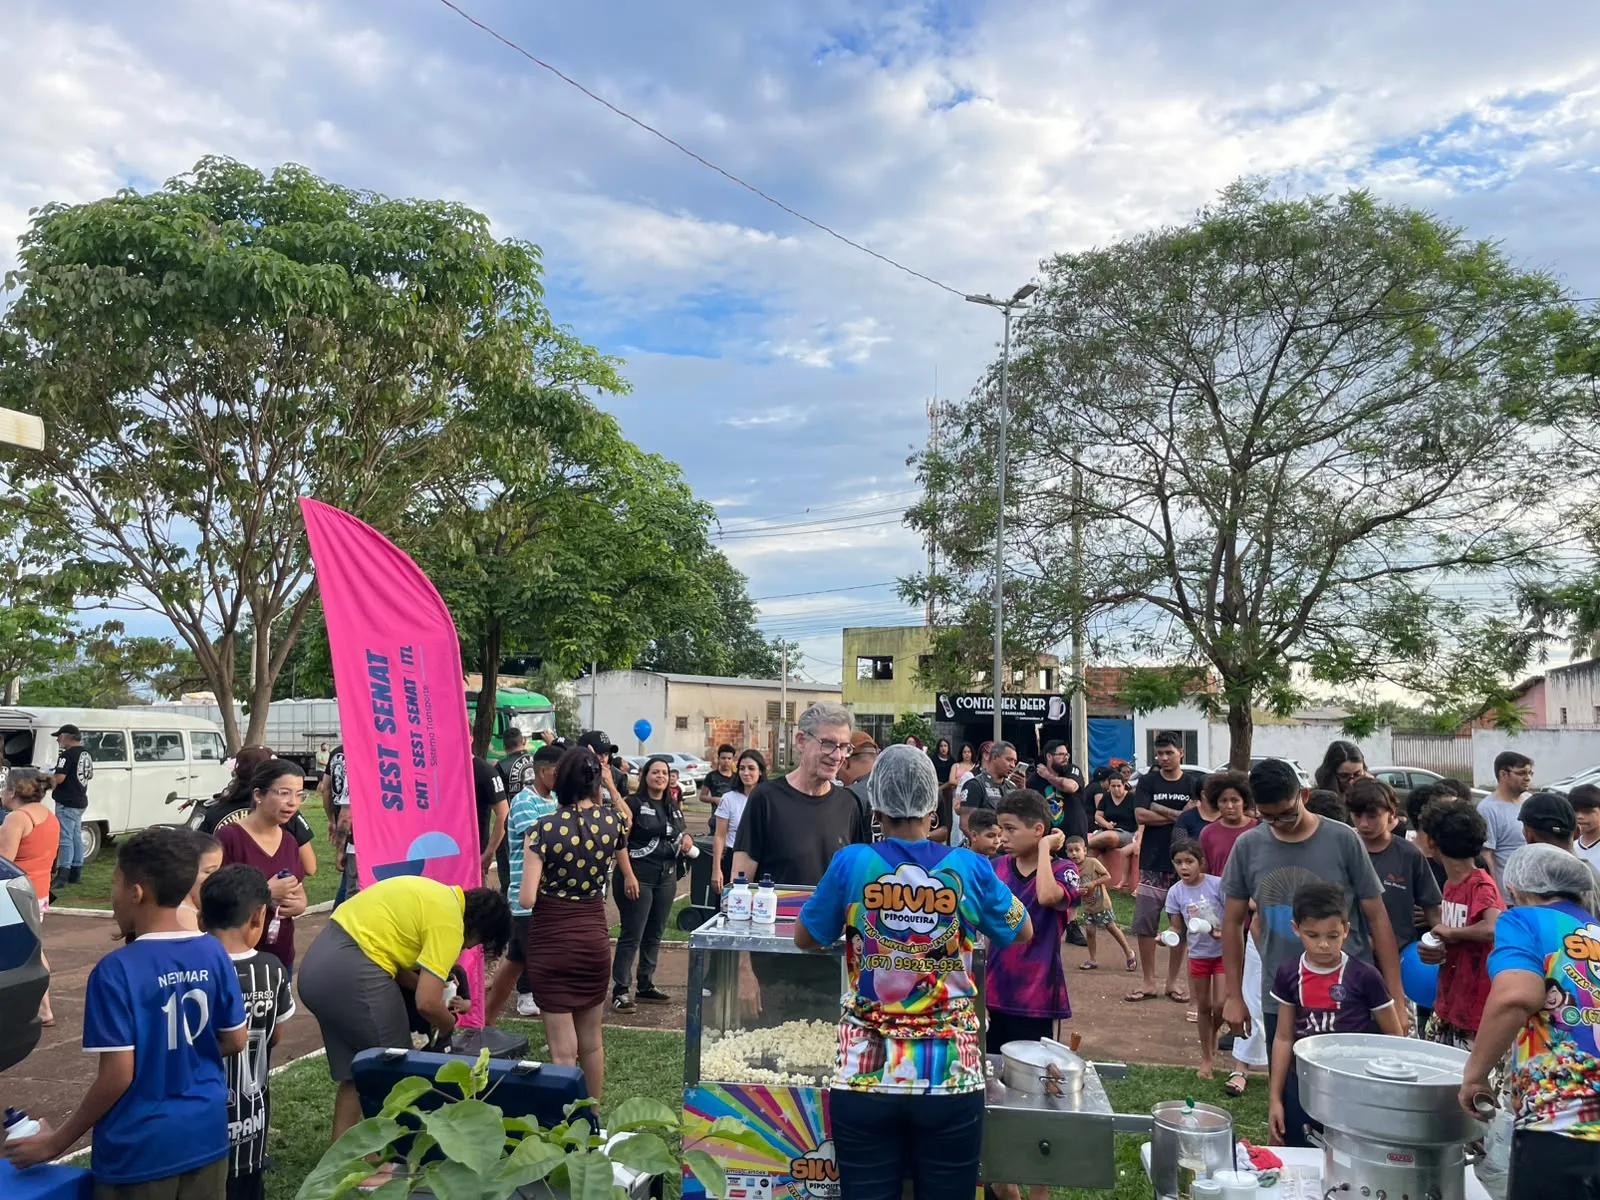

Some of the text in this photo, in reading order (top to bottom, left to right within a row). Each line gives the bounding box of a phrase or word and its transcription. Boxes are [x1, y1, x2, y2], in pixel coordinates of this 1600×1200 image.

[956, 696, 1046, 711] CONTAER BEER
[366, 649, 404, 812] SEST SENAT
[400, 645, 430, 810] CNT SEST SENAT ITL
[422, 685, 438, 767] Sistema Transporte
[1153, 793, 1167, 801] BEM
[884, 913, 935, 925] PIPOQUEIRA
[866, 955, 892, 971] (67)
[158, 969, 209, 988] NEYMAR
[242, 990, 274, 1001] IVERSO
[161, 988, 209, 1051] 10
[791, 1158, 840, 1181] SILV
[809, 1182, 840, 1190] PIPOQUE
